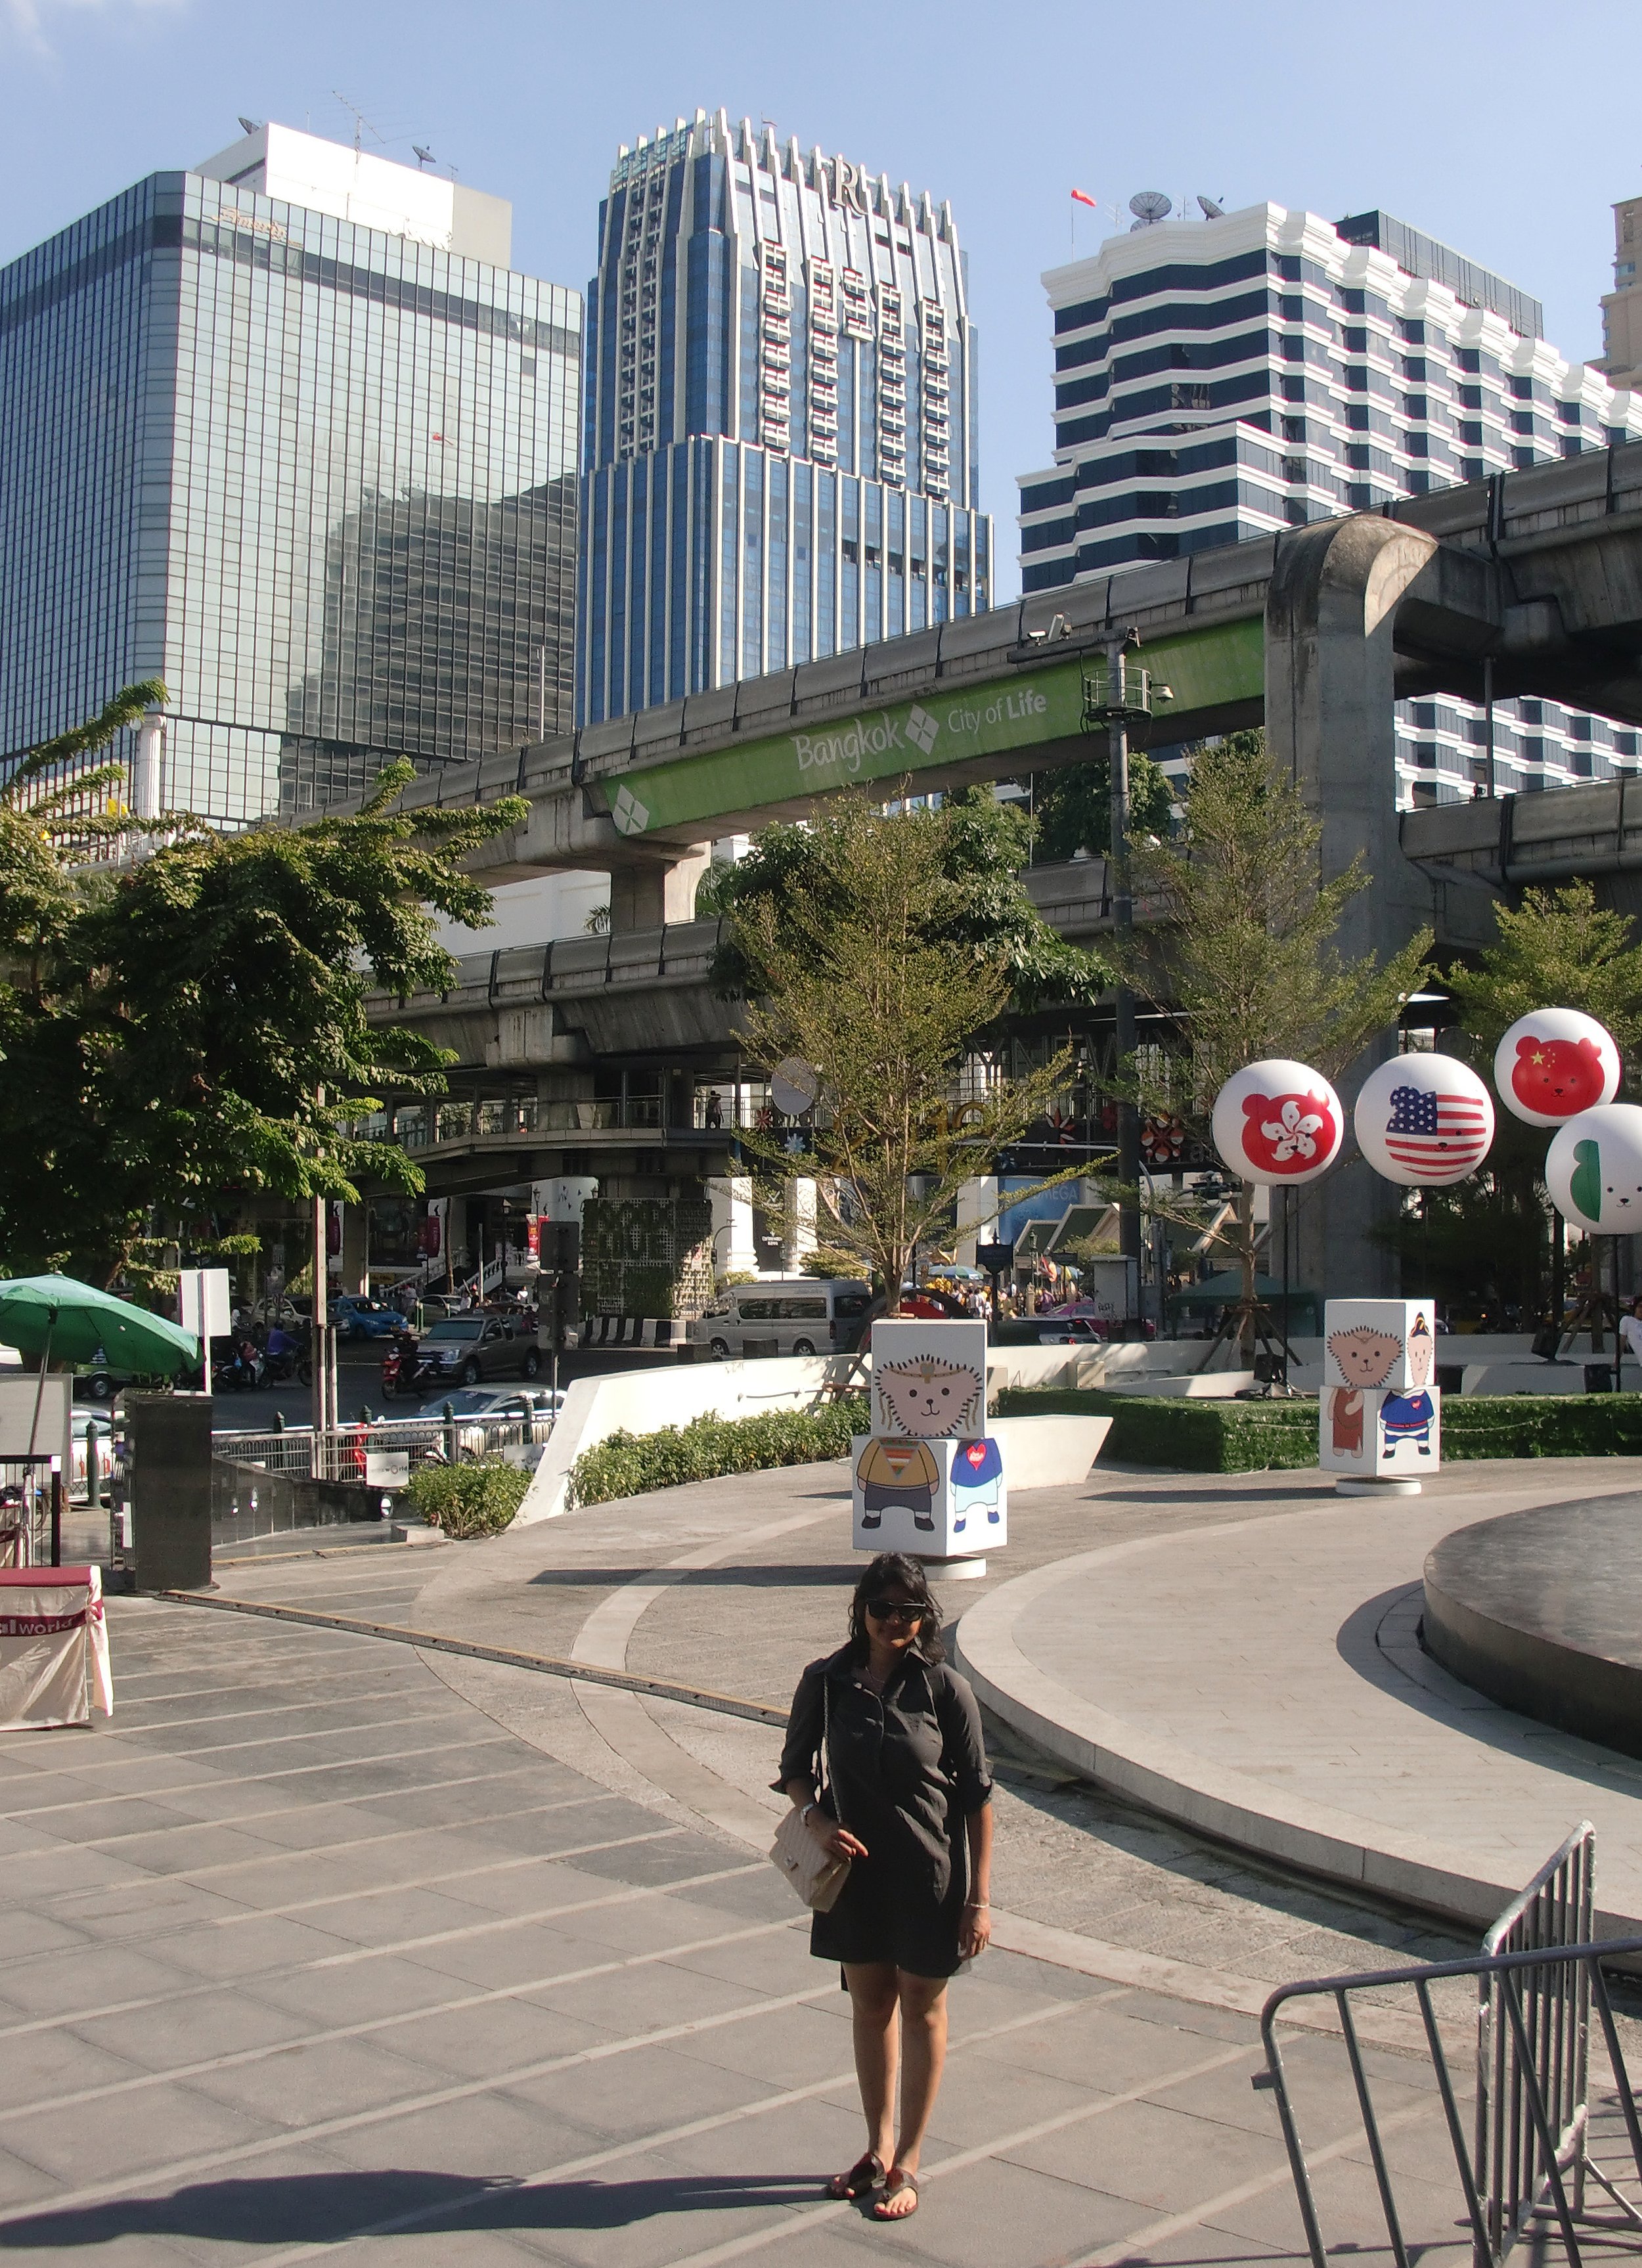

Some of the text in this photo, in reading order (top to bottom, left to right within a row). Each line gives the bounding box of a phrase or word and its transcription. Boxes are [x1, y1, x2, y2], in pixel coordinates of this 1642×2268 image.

[830, 158, 868, 215] R
[789, 690, 1047, 772] Bangkok City of Life
